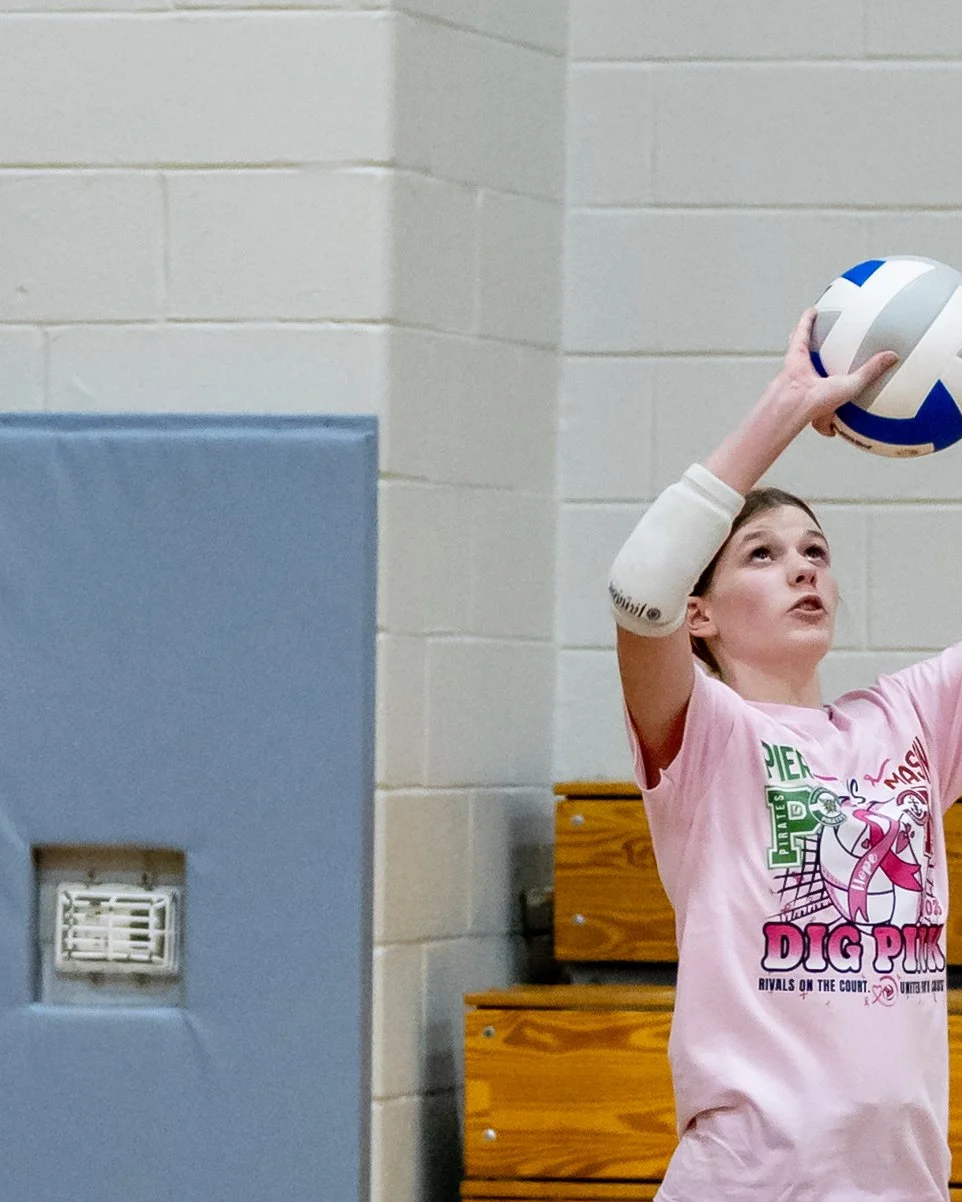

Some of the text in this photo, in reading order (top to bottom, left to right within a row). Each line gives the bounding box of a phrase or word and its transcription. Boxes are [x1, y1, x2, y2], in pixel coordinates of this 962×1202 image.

[774, 794, 790, 855] PIRATES
[761, 922, 863, 973] DIG
[759, 978, 795, 992] RIVALS
[799, 979, 813, 992] ON
[817, 979, 835, 993] THE
[839, 980, 871, 993] COURT.
